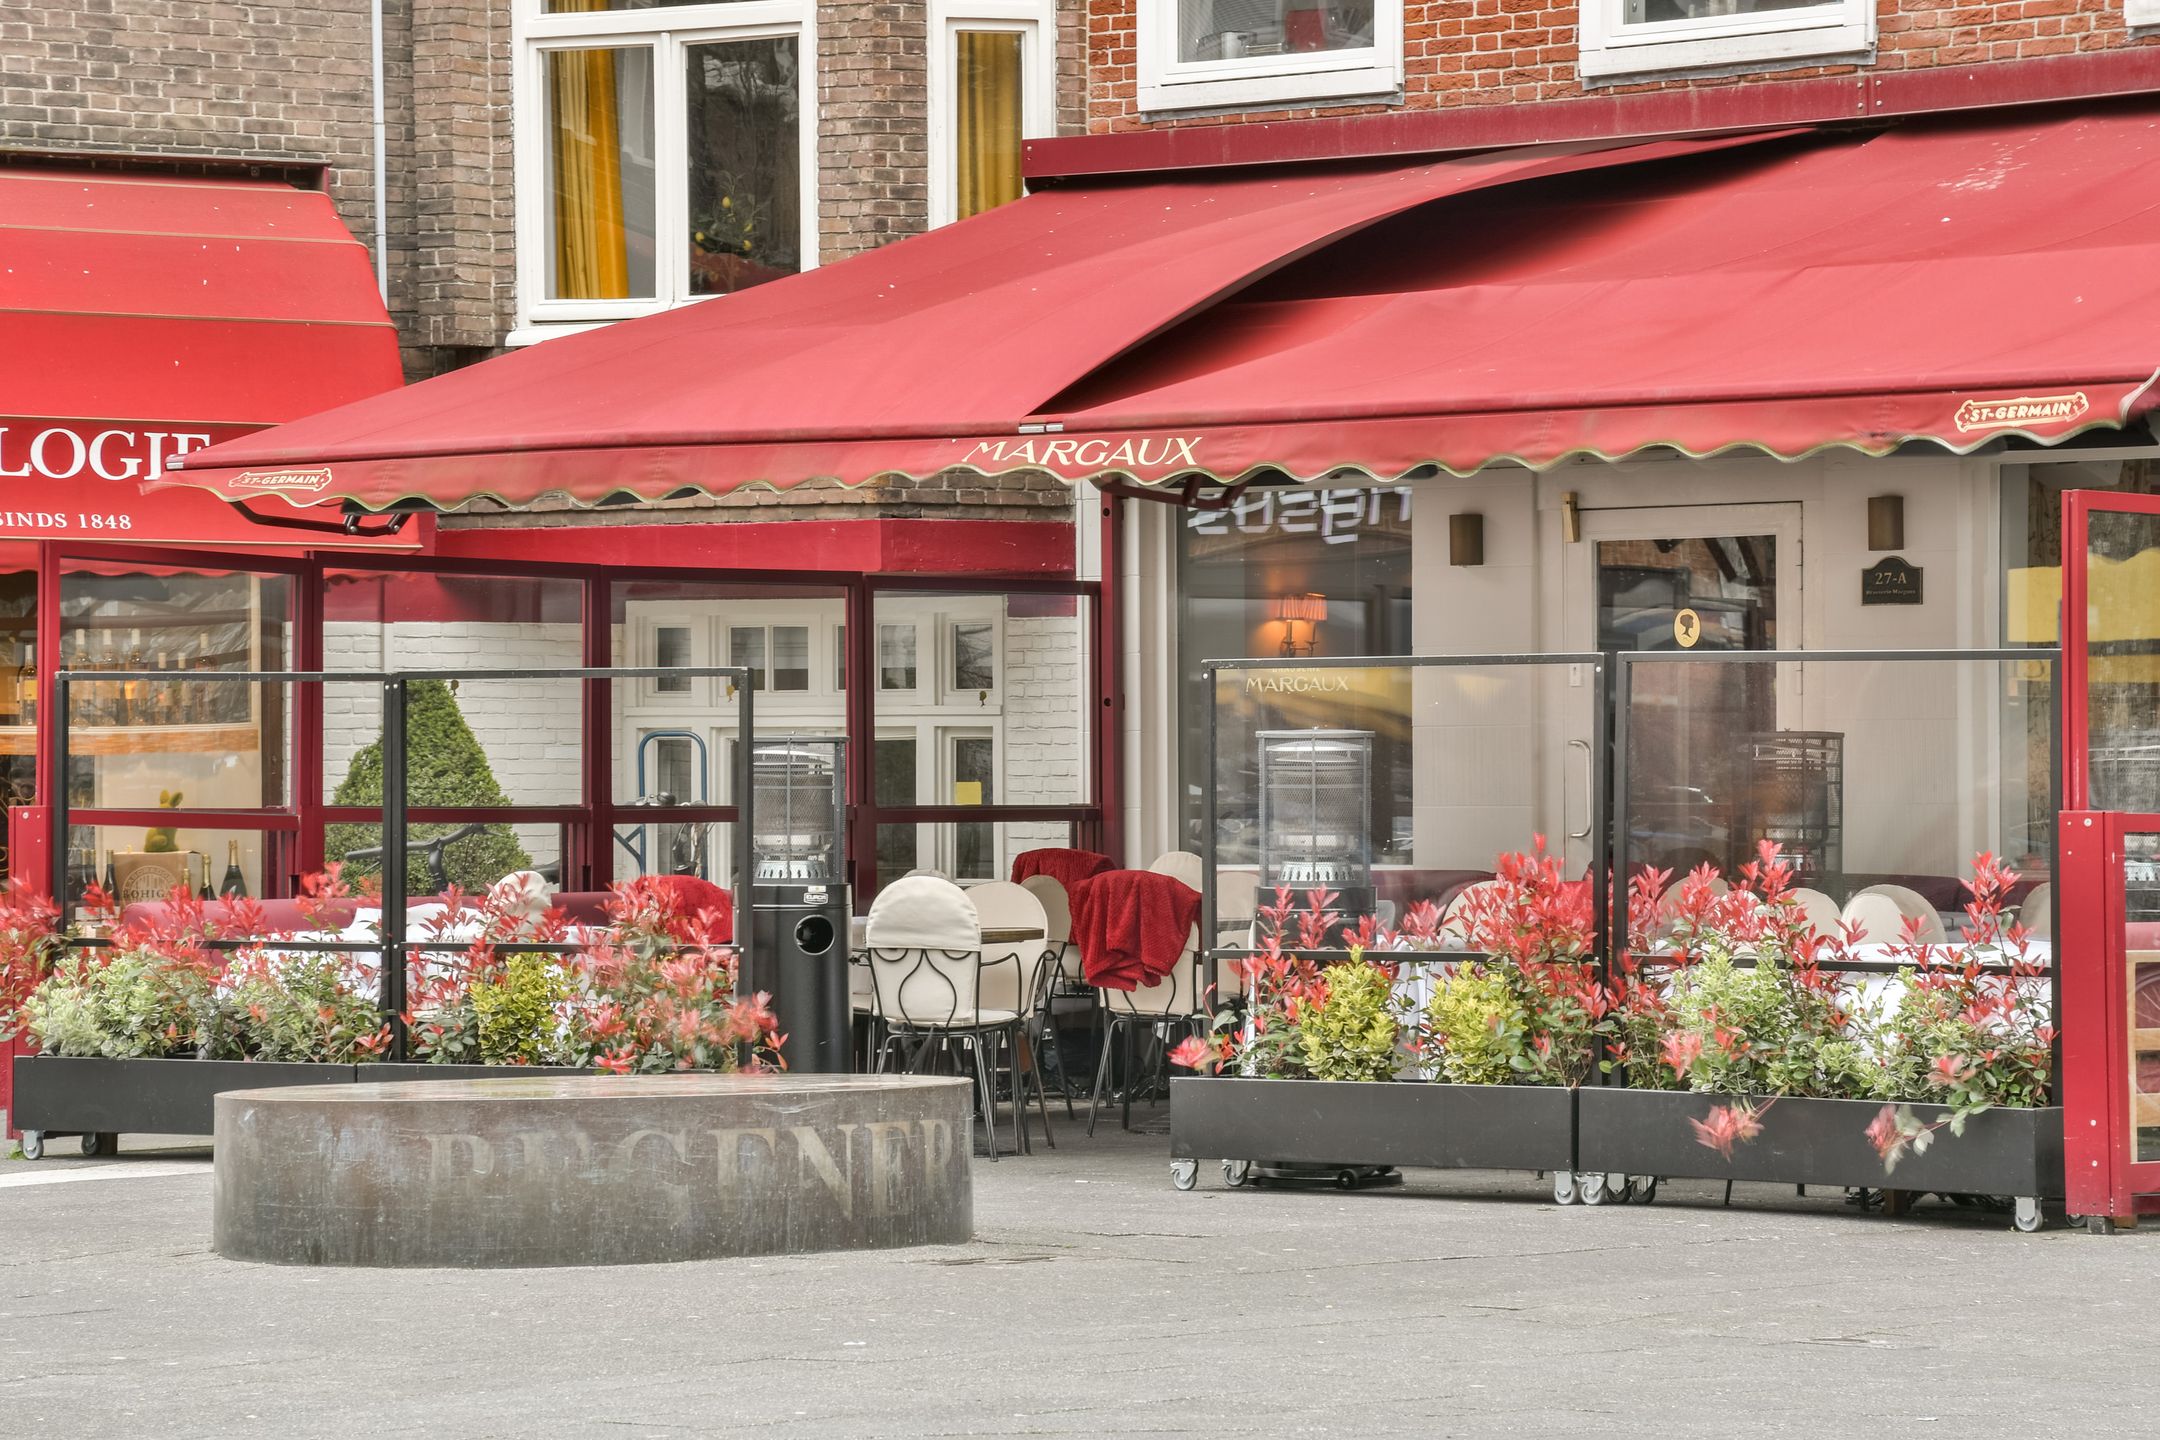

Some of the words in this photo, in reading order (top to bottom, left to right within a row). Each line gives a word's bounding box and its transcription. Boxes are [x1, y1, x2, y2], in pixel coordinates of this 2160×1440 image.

[1970, 402, 2072, 422] ST-GERMAIN
[961, 437, 1203, 466] MARGAUX
[241, 475, 321, 485] ST-GERMAIN
[78, 513, 132, 530] 1848
[1875, 571, 1907, 585] 27-A
[1245, 675, 1350, 693] MARGAUX
